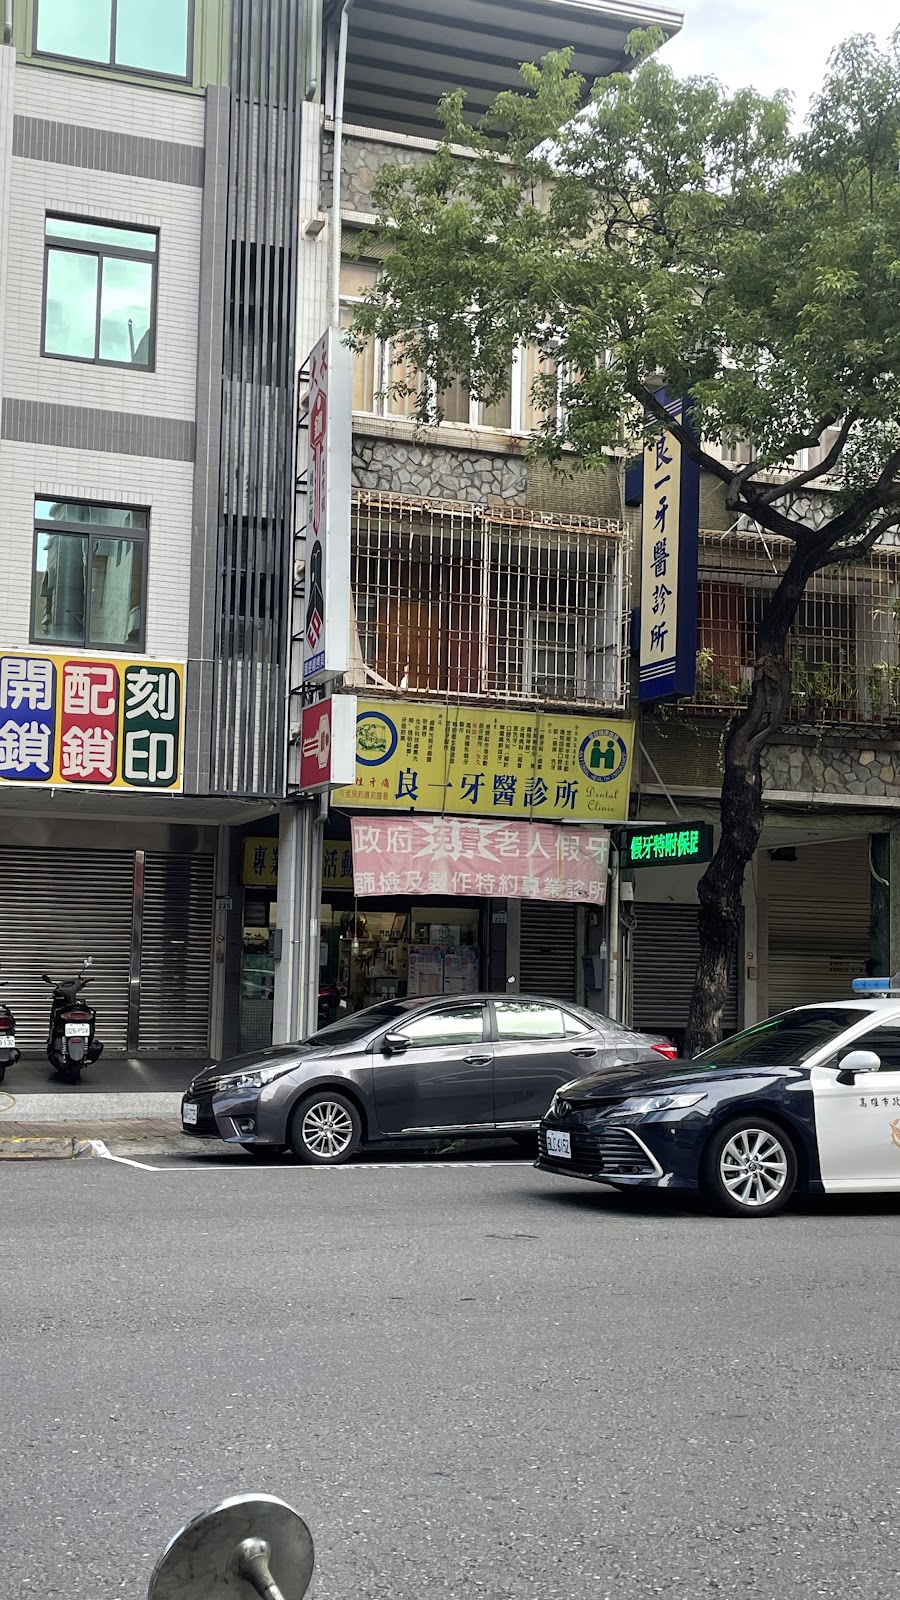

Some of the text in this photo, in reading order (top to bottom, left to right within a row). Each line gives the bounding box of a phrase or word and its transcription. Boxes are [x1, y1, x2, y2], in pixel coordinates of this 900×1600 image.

[650, 427, 673, 653] 良一牙醫診所
[0, 657, 53, 773] 開鎖
[62, 665, 115, 779] 配鎖
[124, 668, 176, 783] 刻印
[394, 767, 580, 810] 良一牙醫診所
[585, 786, 619, 800] Dental
[587, 799, 616, 812] Clinic
[354, 870, 606, 903] 篩檢及製作特約專業診所
